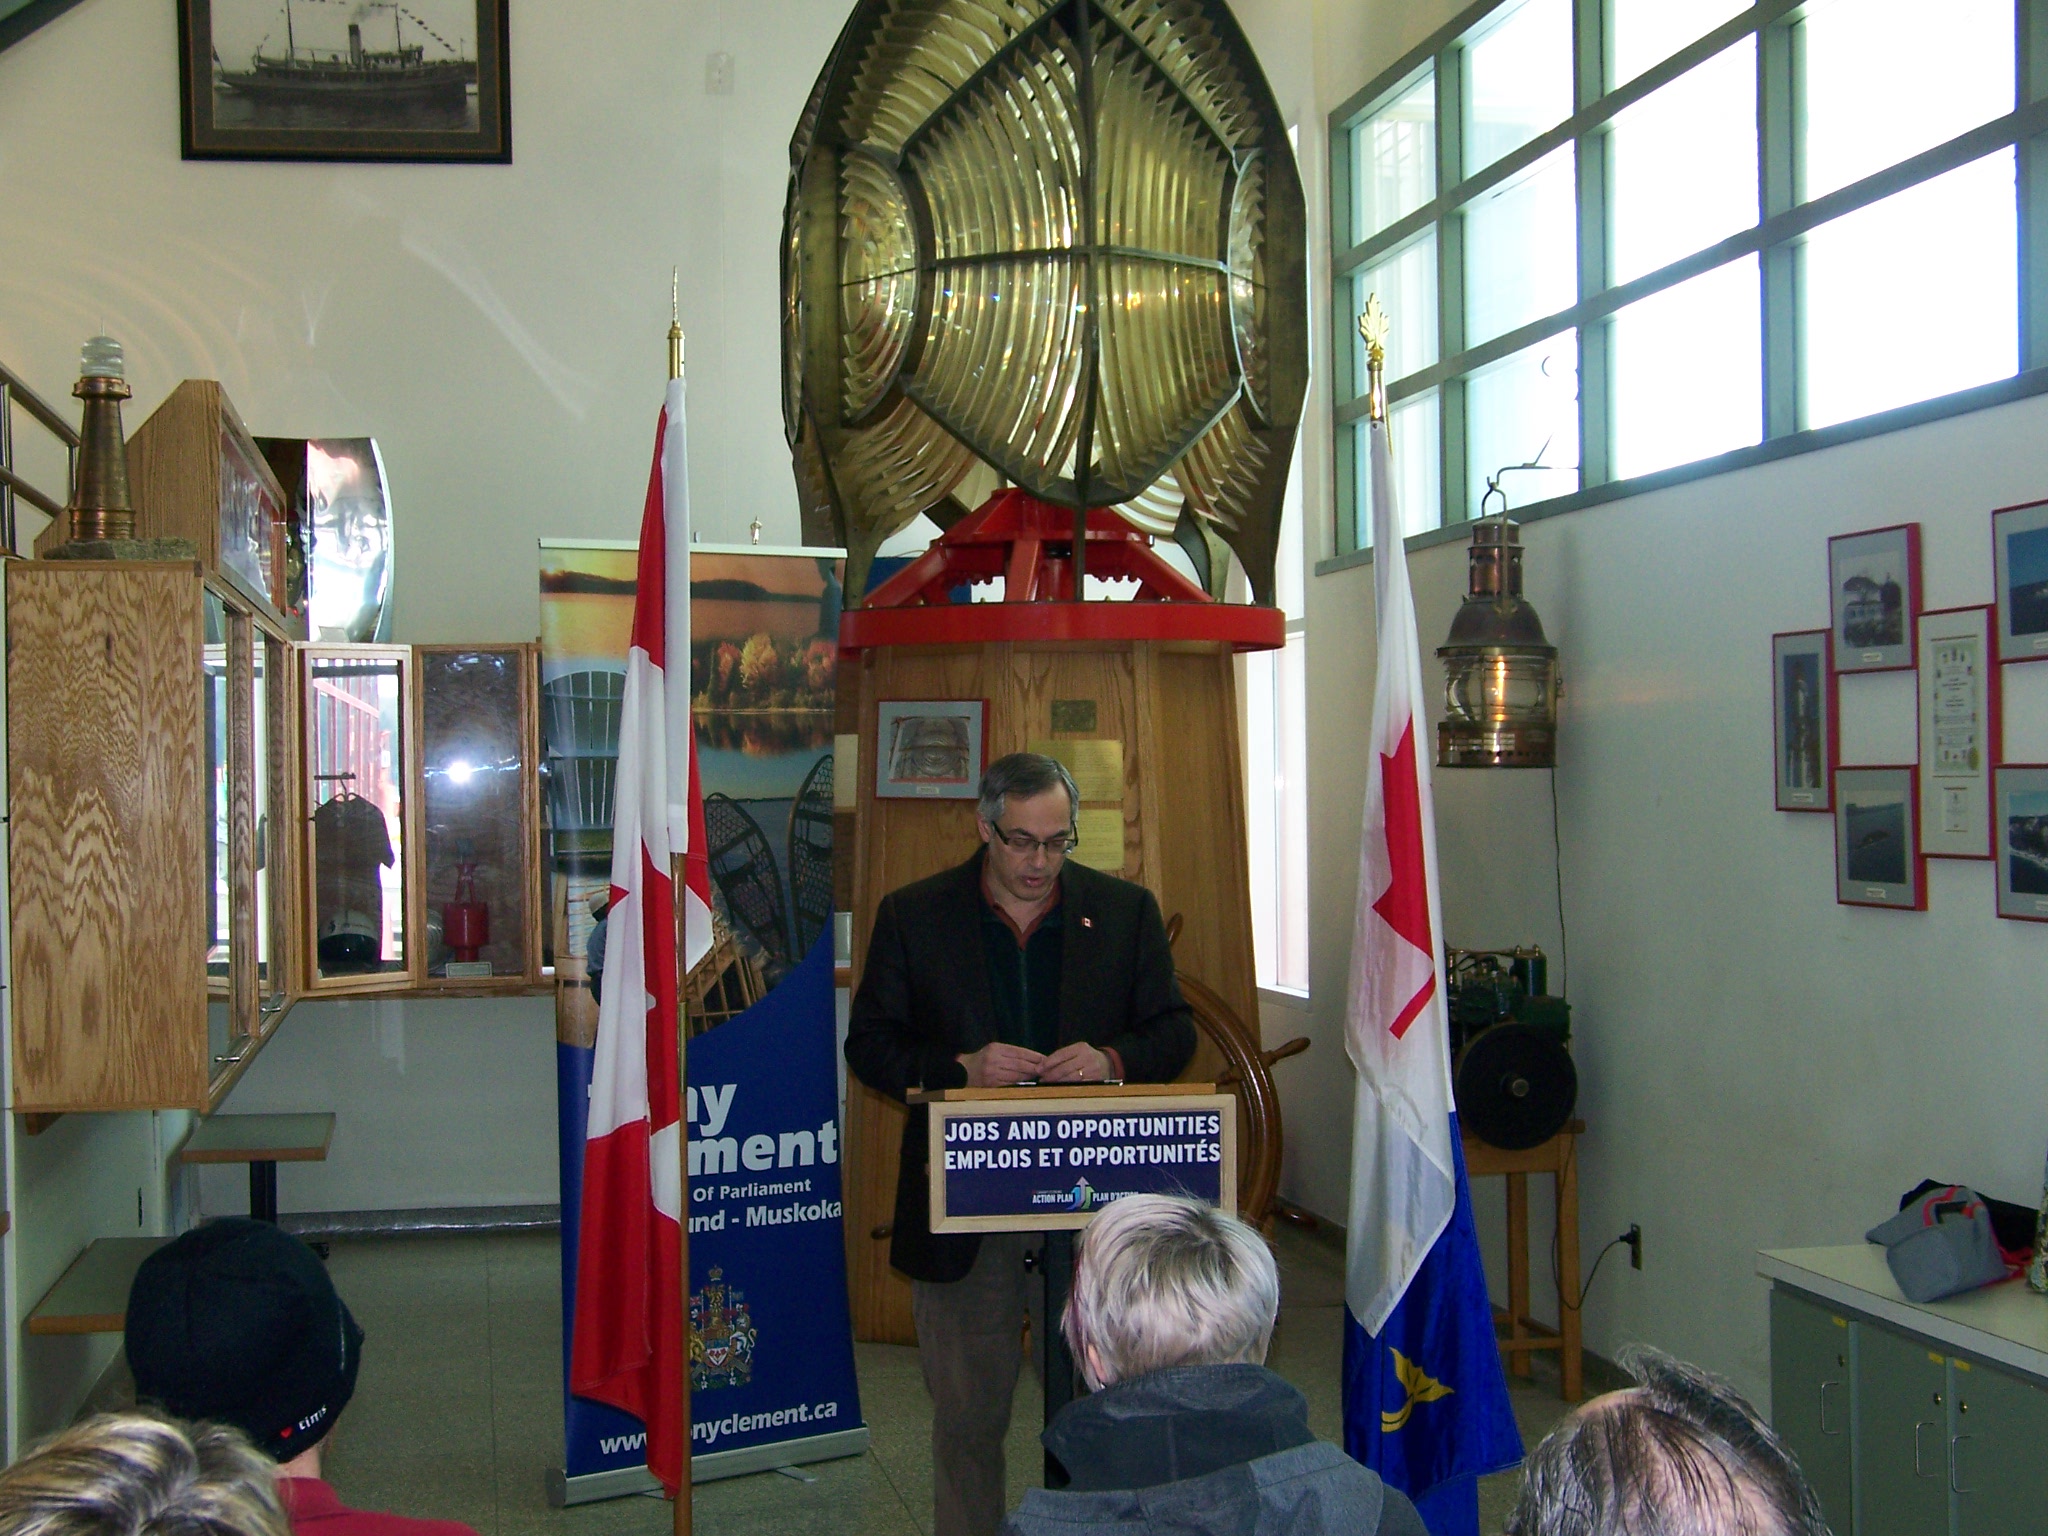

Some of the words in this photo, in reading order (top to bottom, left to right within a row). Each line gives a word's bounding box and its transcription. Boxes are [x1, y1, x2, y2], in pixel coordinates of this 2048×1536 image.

[945, 1121, 1000, 1142] JOBS
[1007, 1120, 1050, 1141] AND
[1057, 1115, 1220, 1139] OPPORTUNITIES
[945, 1148, 1032, 1170] EMPLOIS
[1038, 1147, 1064, 1167] ET
[1069, 1139, 1221, 1166] OPPORTUNITÉS
[693, 1184, 715, 1203] Of
[720, 1178, 812, 1199] Parliament
[1032, 1194, 1055, 1204] ACTION
[1057, 1193, 1074, 1203] PLAN
[1093, 1192, 1109, 1202] PLAN
[746, 1199, 842, 1228] Muskoka
